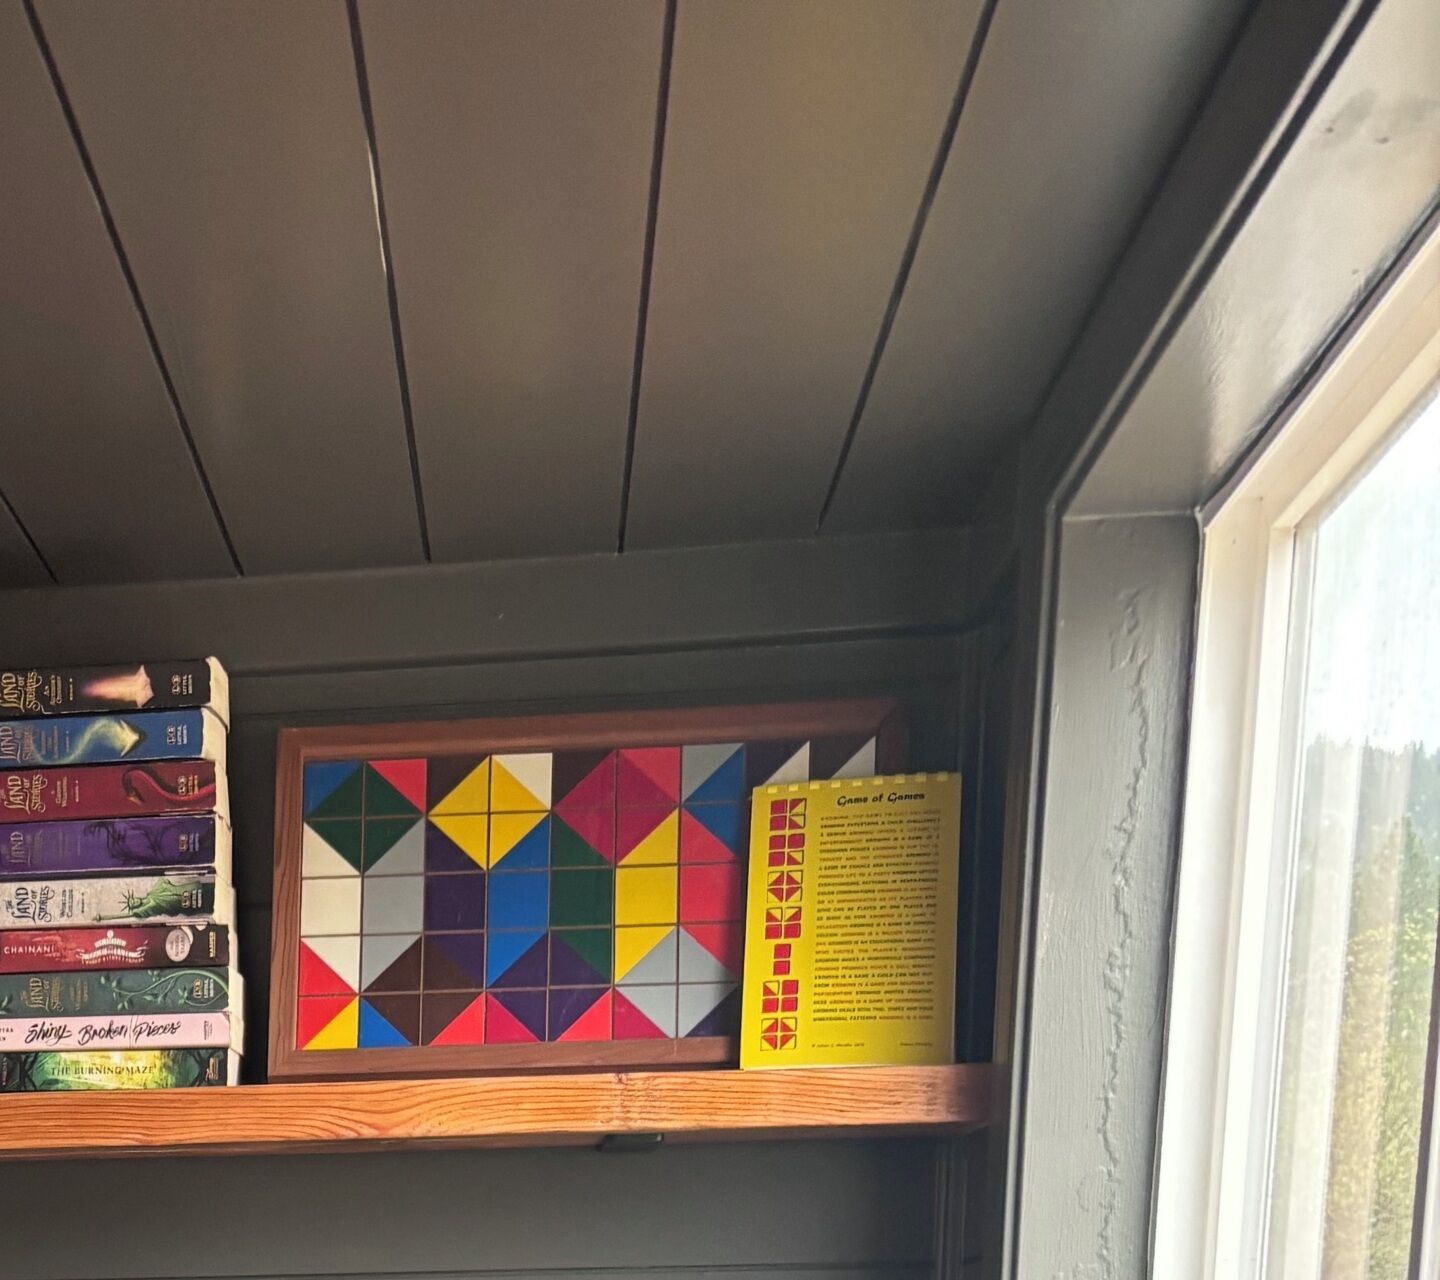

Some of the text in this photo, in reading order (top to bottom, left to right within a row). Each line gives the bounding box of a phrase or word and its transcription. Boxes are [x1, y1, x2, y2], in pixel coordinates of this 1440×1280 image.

[26, 671, 42, 711] STORIES
[5, 776, 31, 814] LAND
[31, 775, 48, 812] STORIES
[837, 792, 925, 806] Game of Games
[7, 832, 32, 866] LAND
[12, 887, 36, 923] LAND
[38, 886, 54, 922] STORIES
[4, 946, 54, 954] CHAINANI
[26, 978, 49, 1011] LAND
[24, 1021, 73, 1046] Shiny
[77, 1022, 127, 1046] Broken
[133, 1021, 181, 1044] Pieces
[51, 1064, 154, 1076] THE BURNING MAZE
